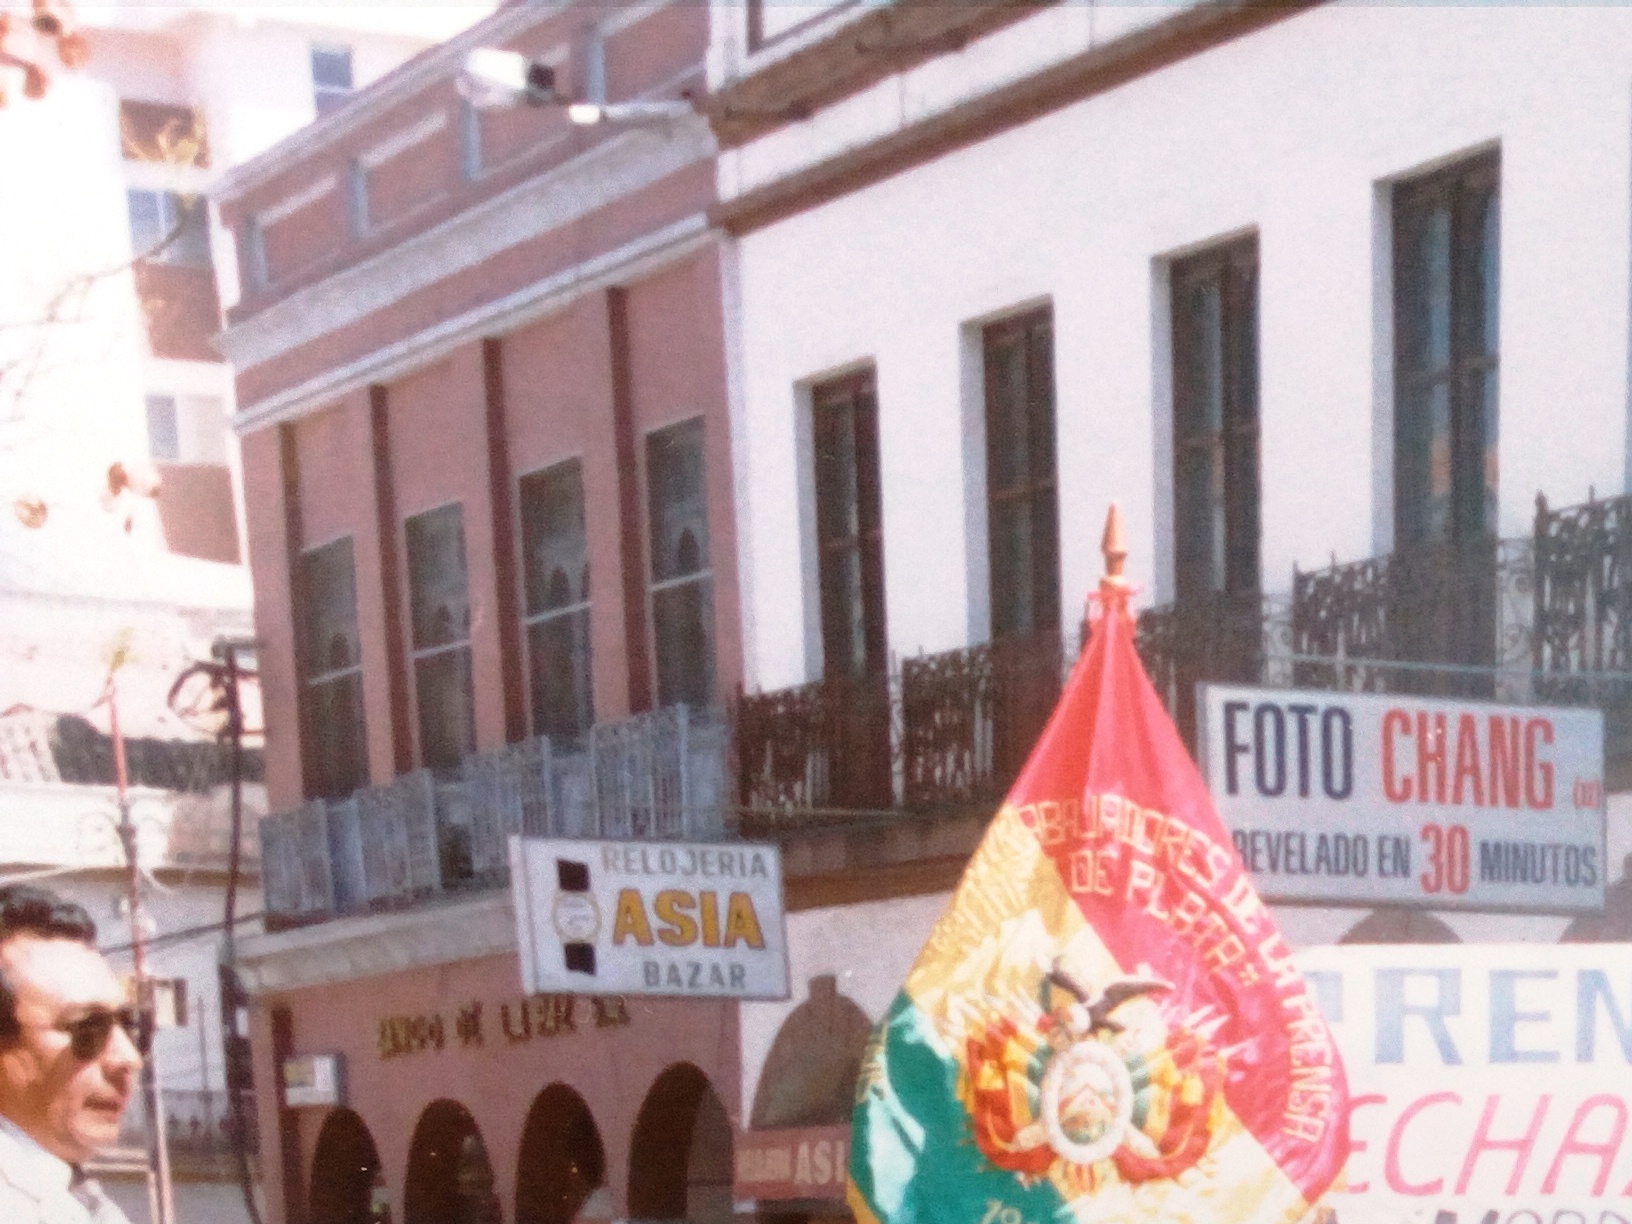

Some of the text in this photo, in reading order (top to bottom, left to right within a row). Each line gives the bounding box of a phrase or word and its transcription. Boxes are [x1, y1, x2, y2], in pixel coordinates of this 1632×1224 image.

[1222, 701, 1556, 811] FOTO CHANG
[601, 845, 769, 879] RELOJERIA
[1231, 823, 1598, 895] REVELADO EN 30 MINUTOS
[612, 887, 767, 951] ASIA
[642, 960, 748, 990] BAZAR
